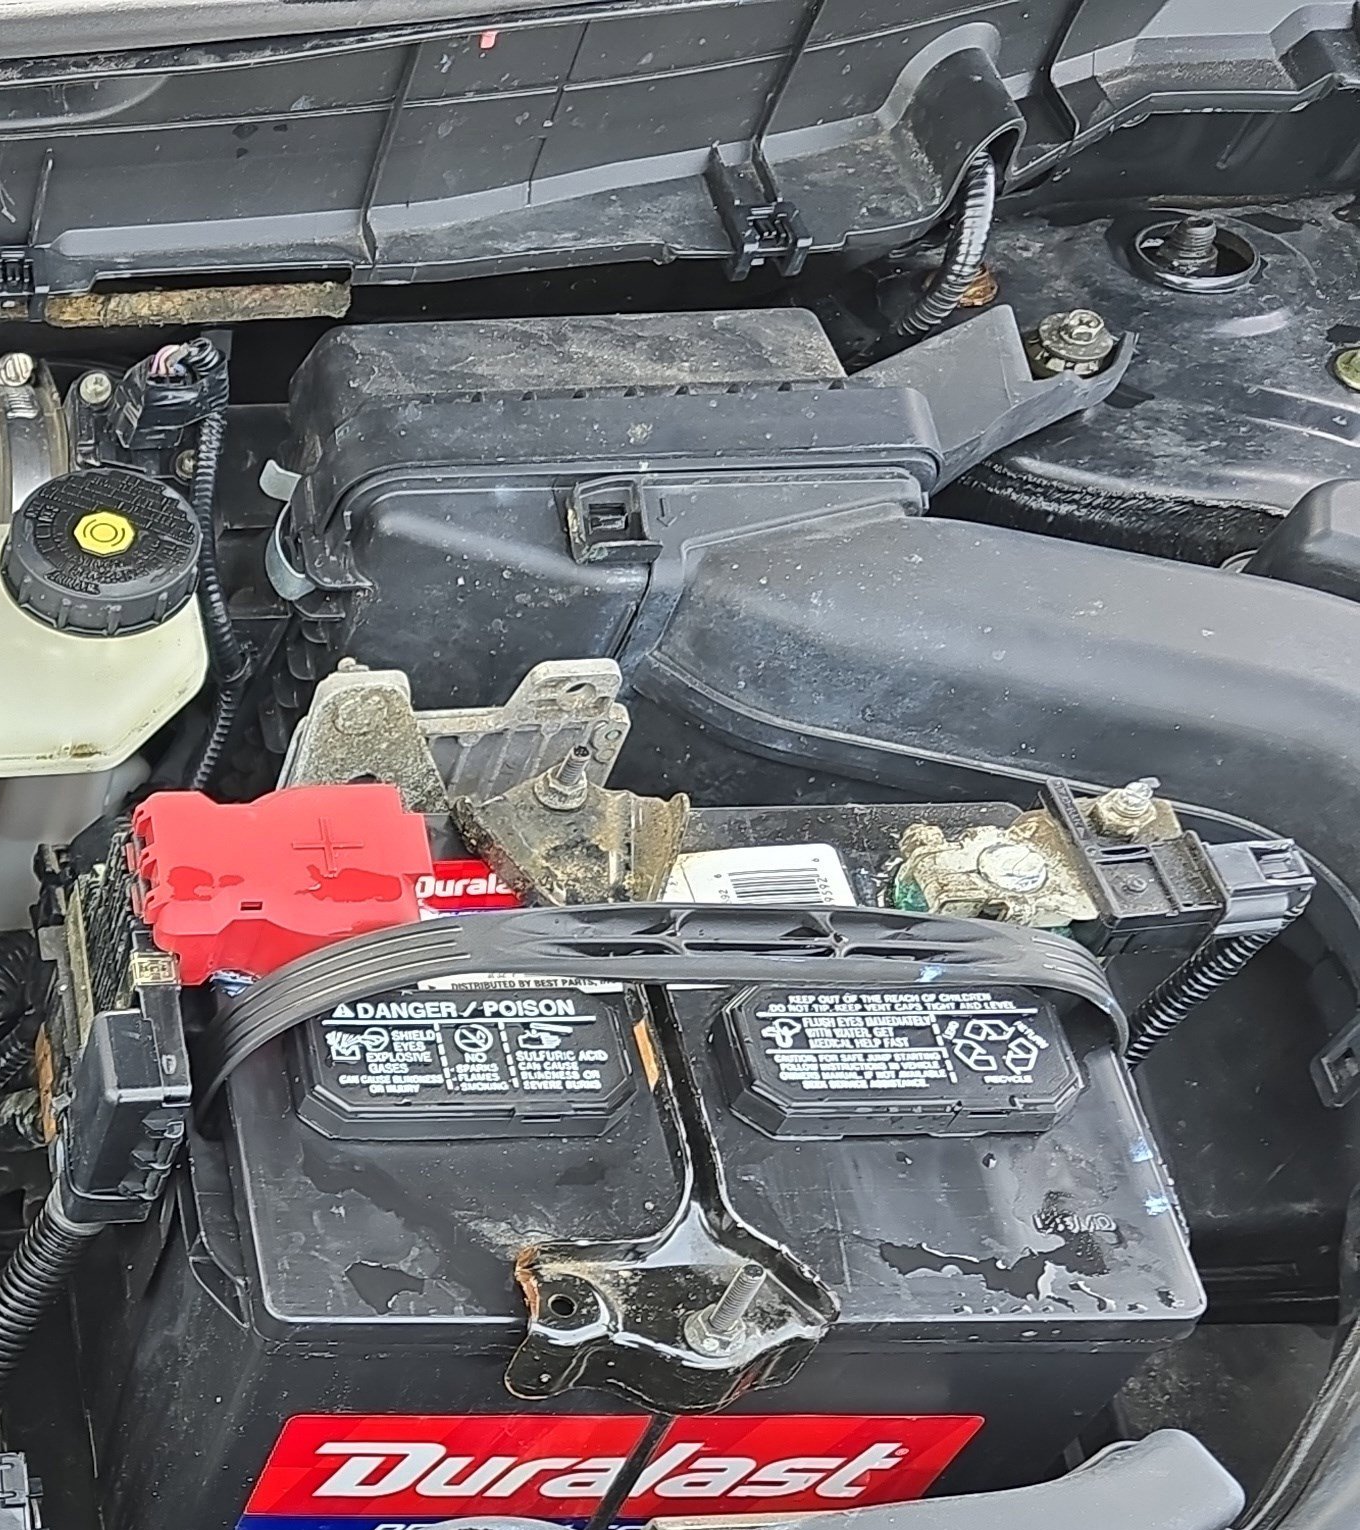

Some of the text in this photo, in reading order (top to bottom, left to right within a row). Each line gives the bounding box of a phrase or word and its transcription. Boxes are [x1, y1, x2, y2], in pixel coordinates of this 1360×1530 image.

[415, 873, 513, 899] Durala
[451, 980, 516, 990] DISTRIBUTED
[518, 979, 530, 988] BY
[533, 978, 559, 988] BEST
[788, 994, 816, 1004] KEEP
[817, 994, 840, 1004] OUT
[841, 993, 858, 1004] OF
[859, 993, 883, 1004] THE
[883, 993, 921, 1003] REACH
[356, 1002, 458, 1019] DANGER
[482, 999, 576, 1017] POISON
[768, 1004, 786, 1013] DO
[787, 1004, 810, 1013] NOT
[834, 1003, 862, 1012] KEEP
[863, 1002, 893, 1012] VENT
[893, 1002, 923, 1011] CAPS
[801, 1016, 837, 1028] FLUSH
[836, 1016, 865, 1027] EYES
[391, 1030, 436, 1041] SHIELD
[872, 1026, 895, 1038] GET
[393, 1041, 426, 1052] EYES
[808, 1036, 910, 1049] MEDICAL HELP FAST
[365, 1051, 433, 1063] EXPLOSIVE
[464, 1052, 488, 1063] NO
[515, 1049, 609, 1062] SULFURIC ACID
[368, 1063, 409, 1074] GASES
[455, 1063, 499, 1074] SPARKS
[517, 1061, 580, 1071] CAN CAUSE
[457, 1072, 501, 1082] FLAMES
[523, 1080, 564, 1091] SEVERE
[313, 1441, 900, 1499] Duralast
